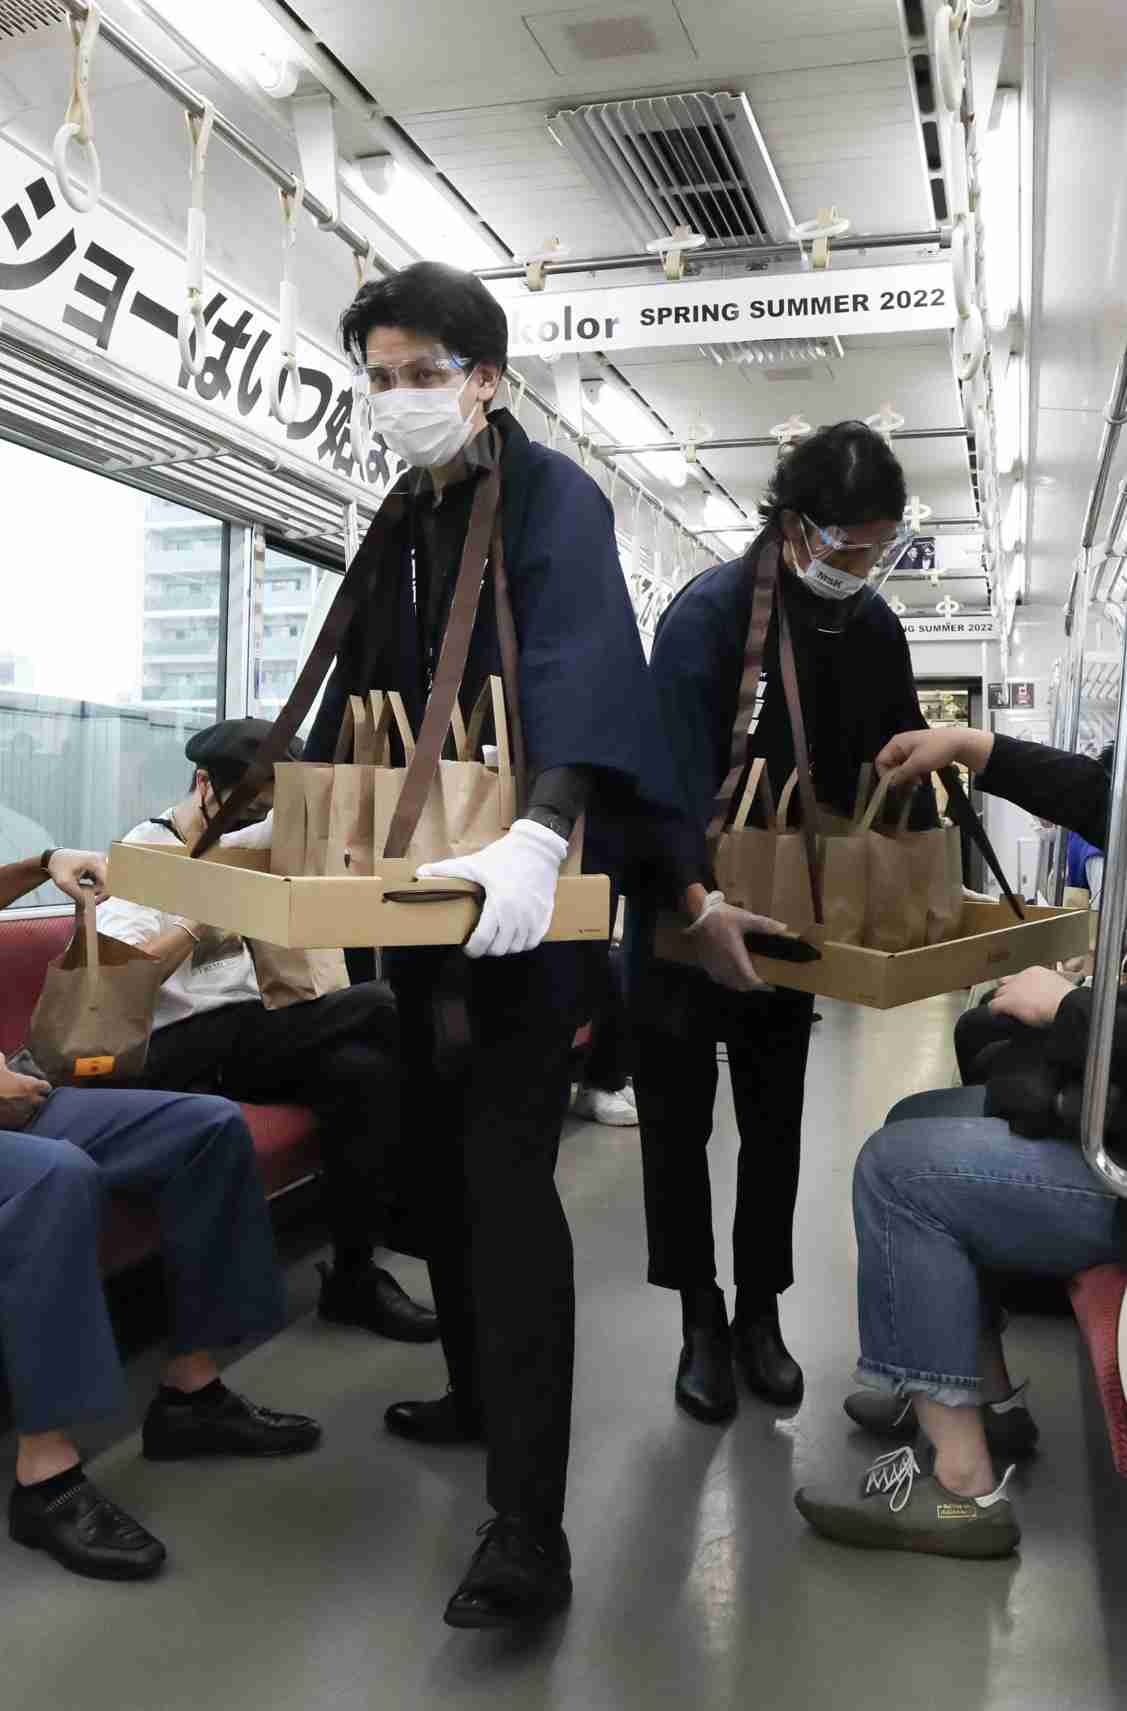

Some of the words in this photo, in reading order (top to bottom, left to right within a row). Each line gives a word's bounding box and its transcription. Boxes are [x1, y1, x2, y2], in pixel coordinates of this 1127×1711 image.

[640, 302, 740, 326] SPRING
[749, 293, 870, 319] SUMMER
[879, 288, 946, 311] 2022
[918, 622, 966, 633] SUMMER
[966, 623, 993, 632] 2022
